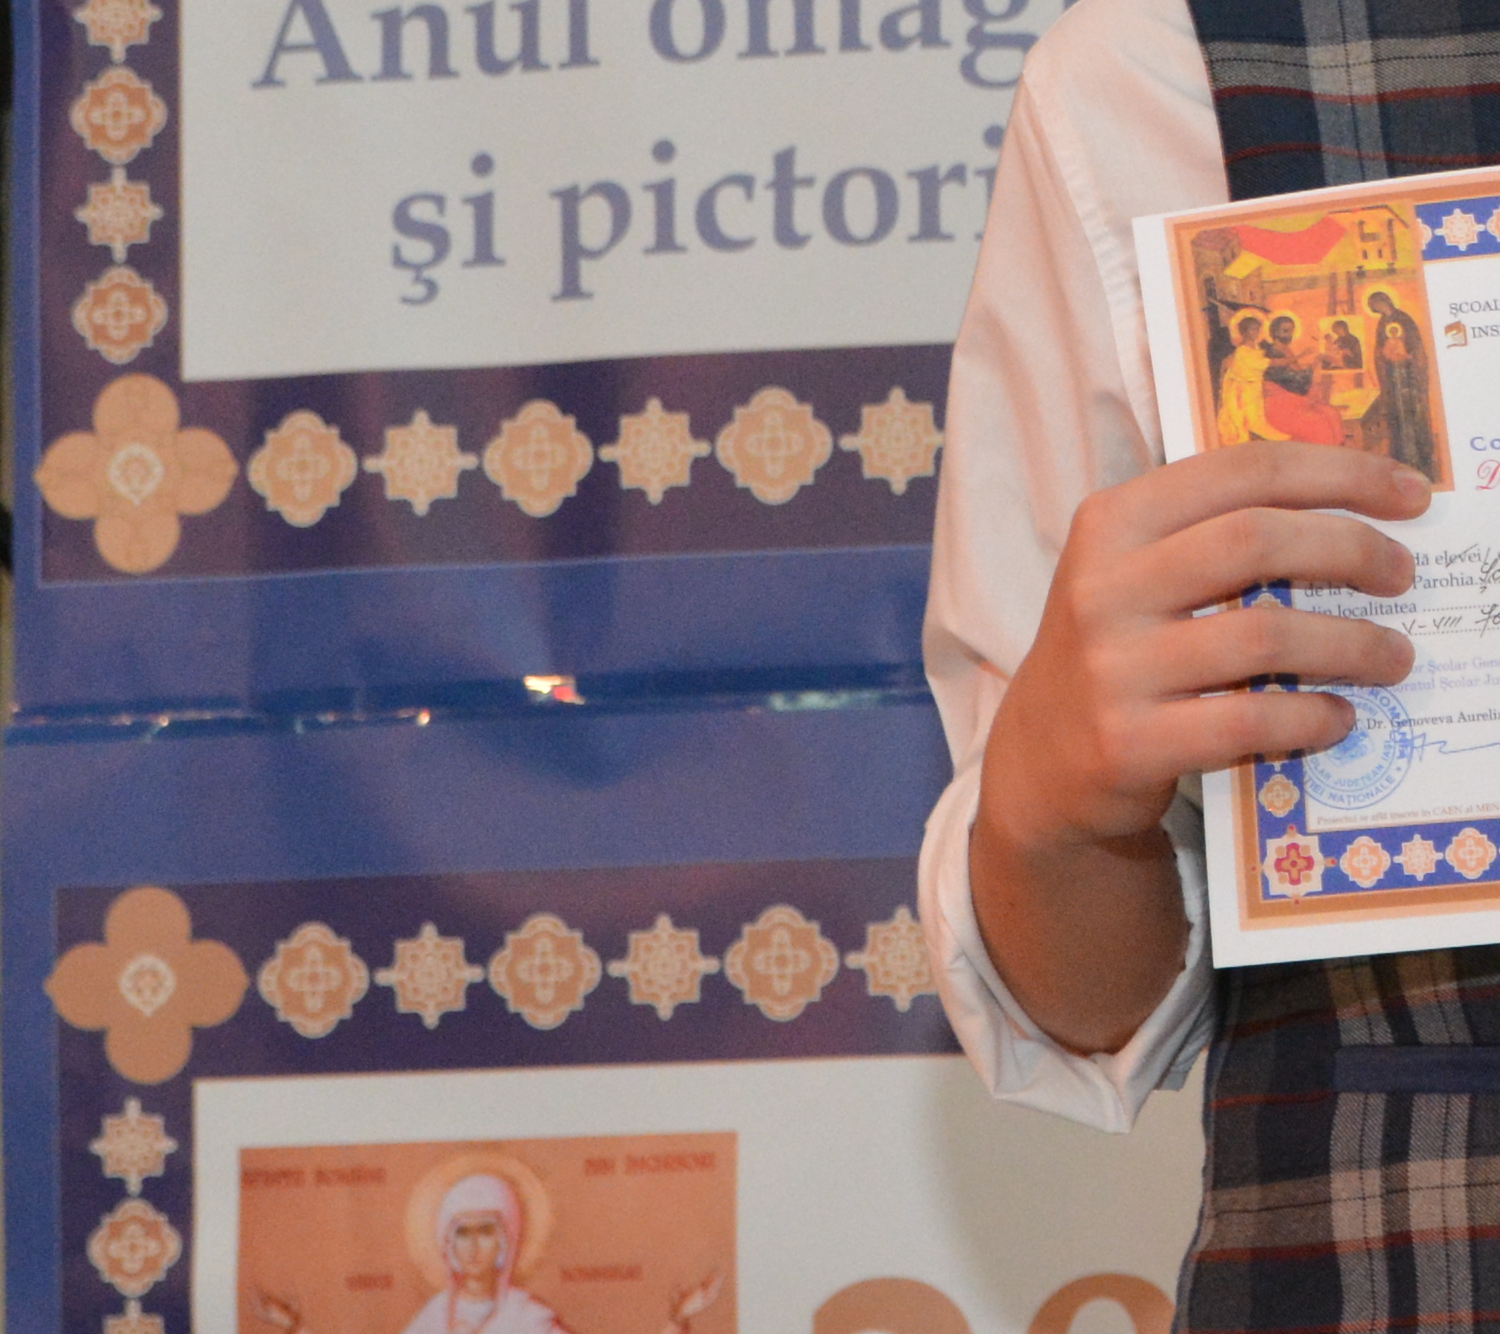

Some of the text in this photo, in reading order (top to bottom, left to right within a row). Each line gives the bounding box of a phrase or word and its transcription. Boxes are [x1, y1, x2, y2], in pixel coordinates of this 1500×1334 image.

[1412, 573, 1475, 590] Parohia
[1336, 601, 1418, 618] localitatea
[1366, 717, 1388, 730] Dr.
